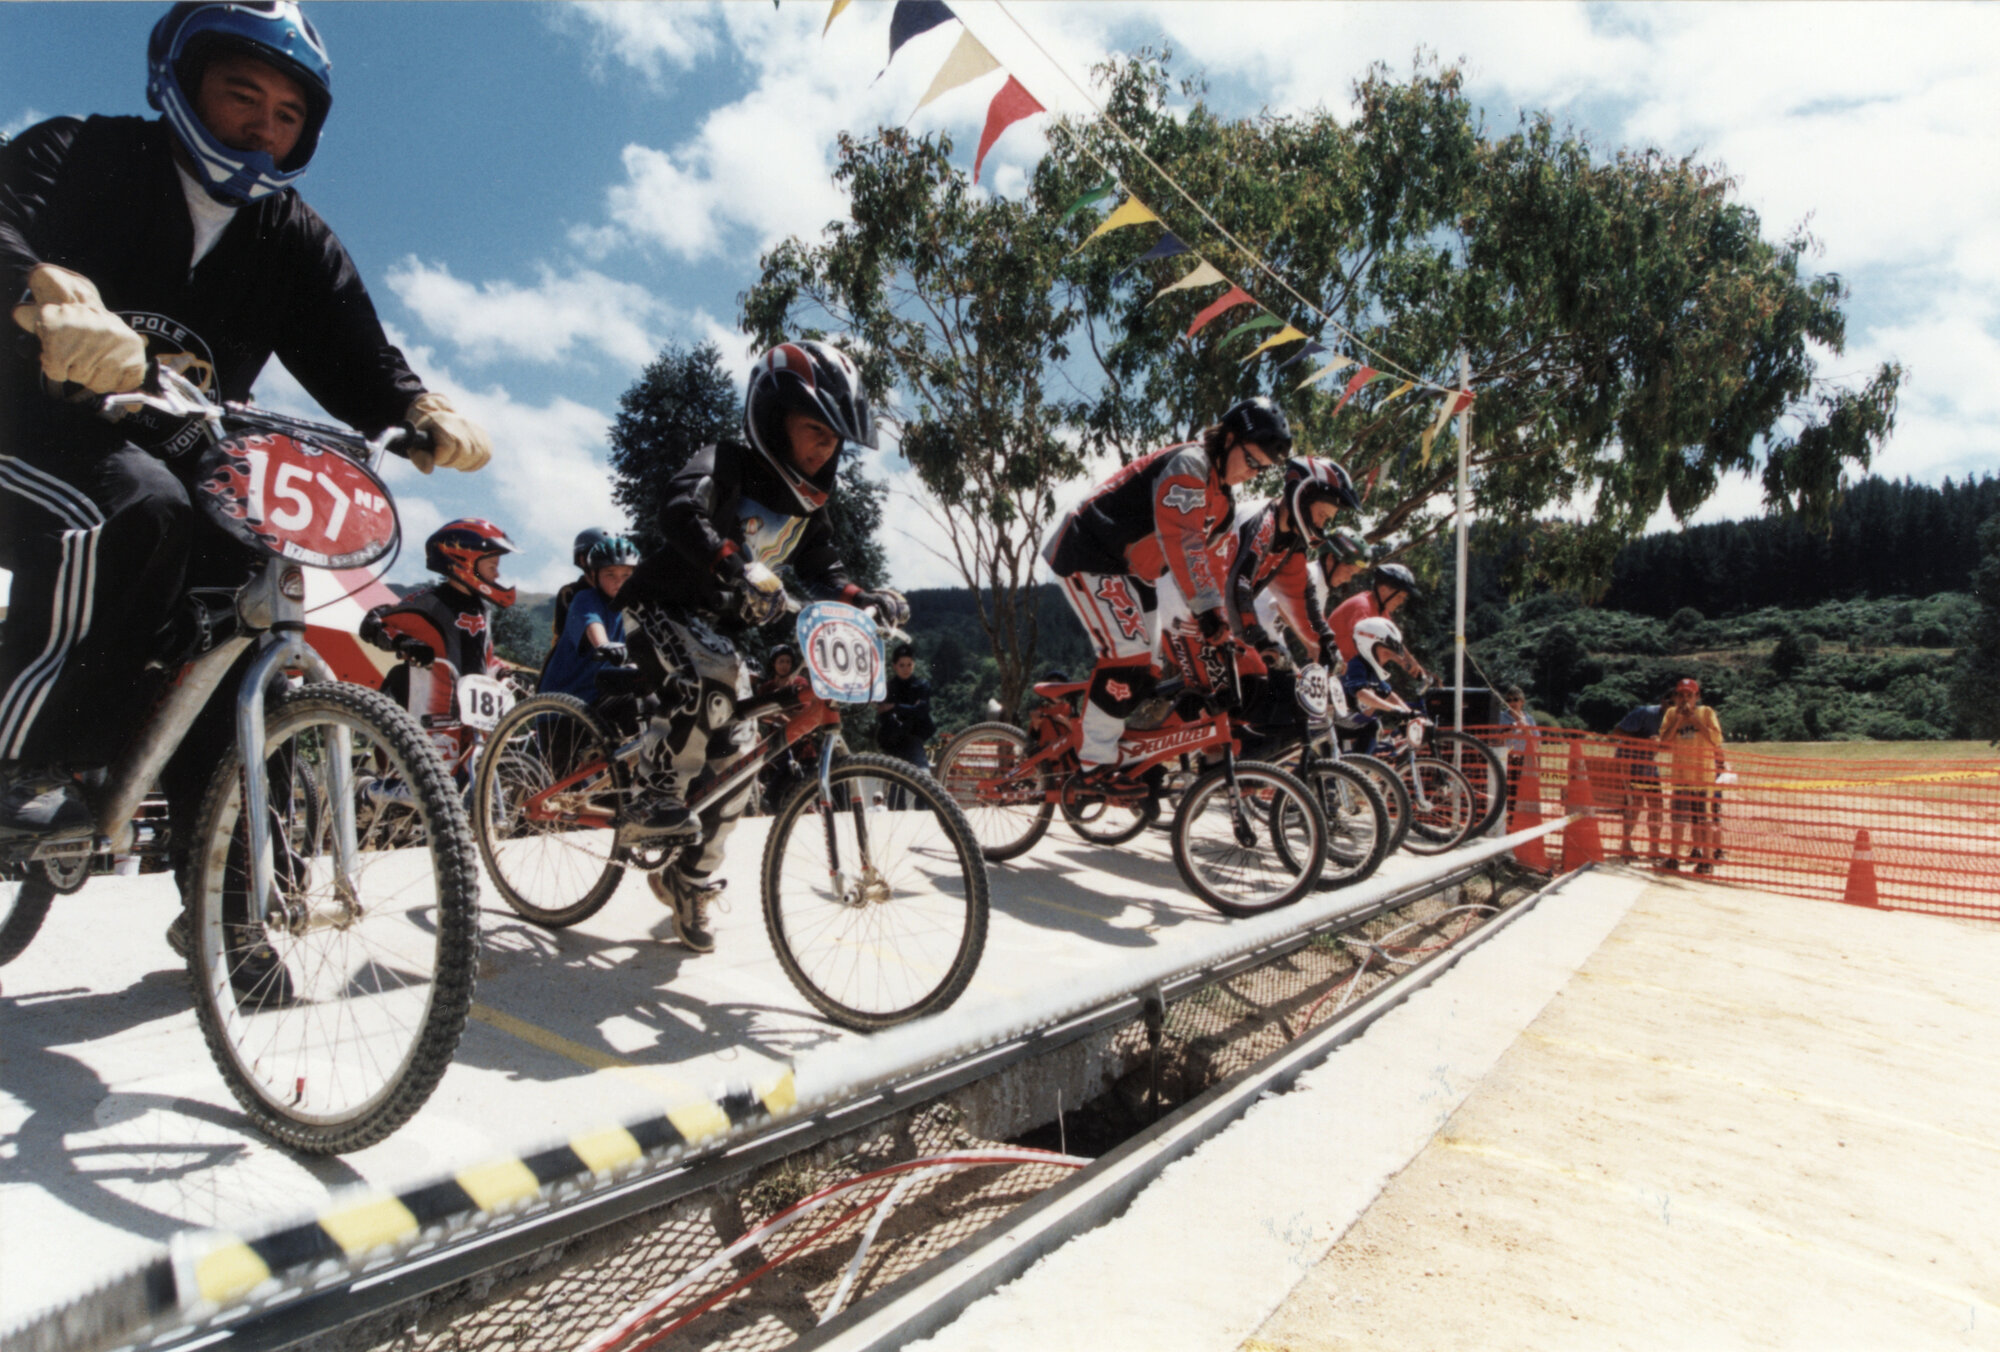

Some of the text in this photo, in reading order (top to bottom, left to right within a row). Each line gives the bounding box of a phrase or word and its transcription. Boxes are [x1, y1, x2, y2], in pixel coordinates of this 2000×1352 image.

[131, 315, 187, 343] POLE
[246, 449, 350, 542] 157
[354, 487, 387, 514] NP
[814, 635, 870, 677] 108
[469, 688, 503, 720] 181
[1117, 725, 1212, 762] SPECIALIZED
